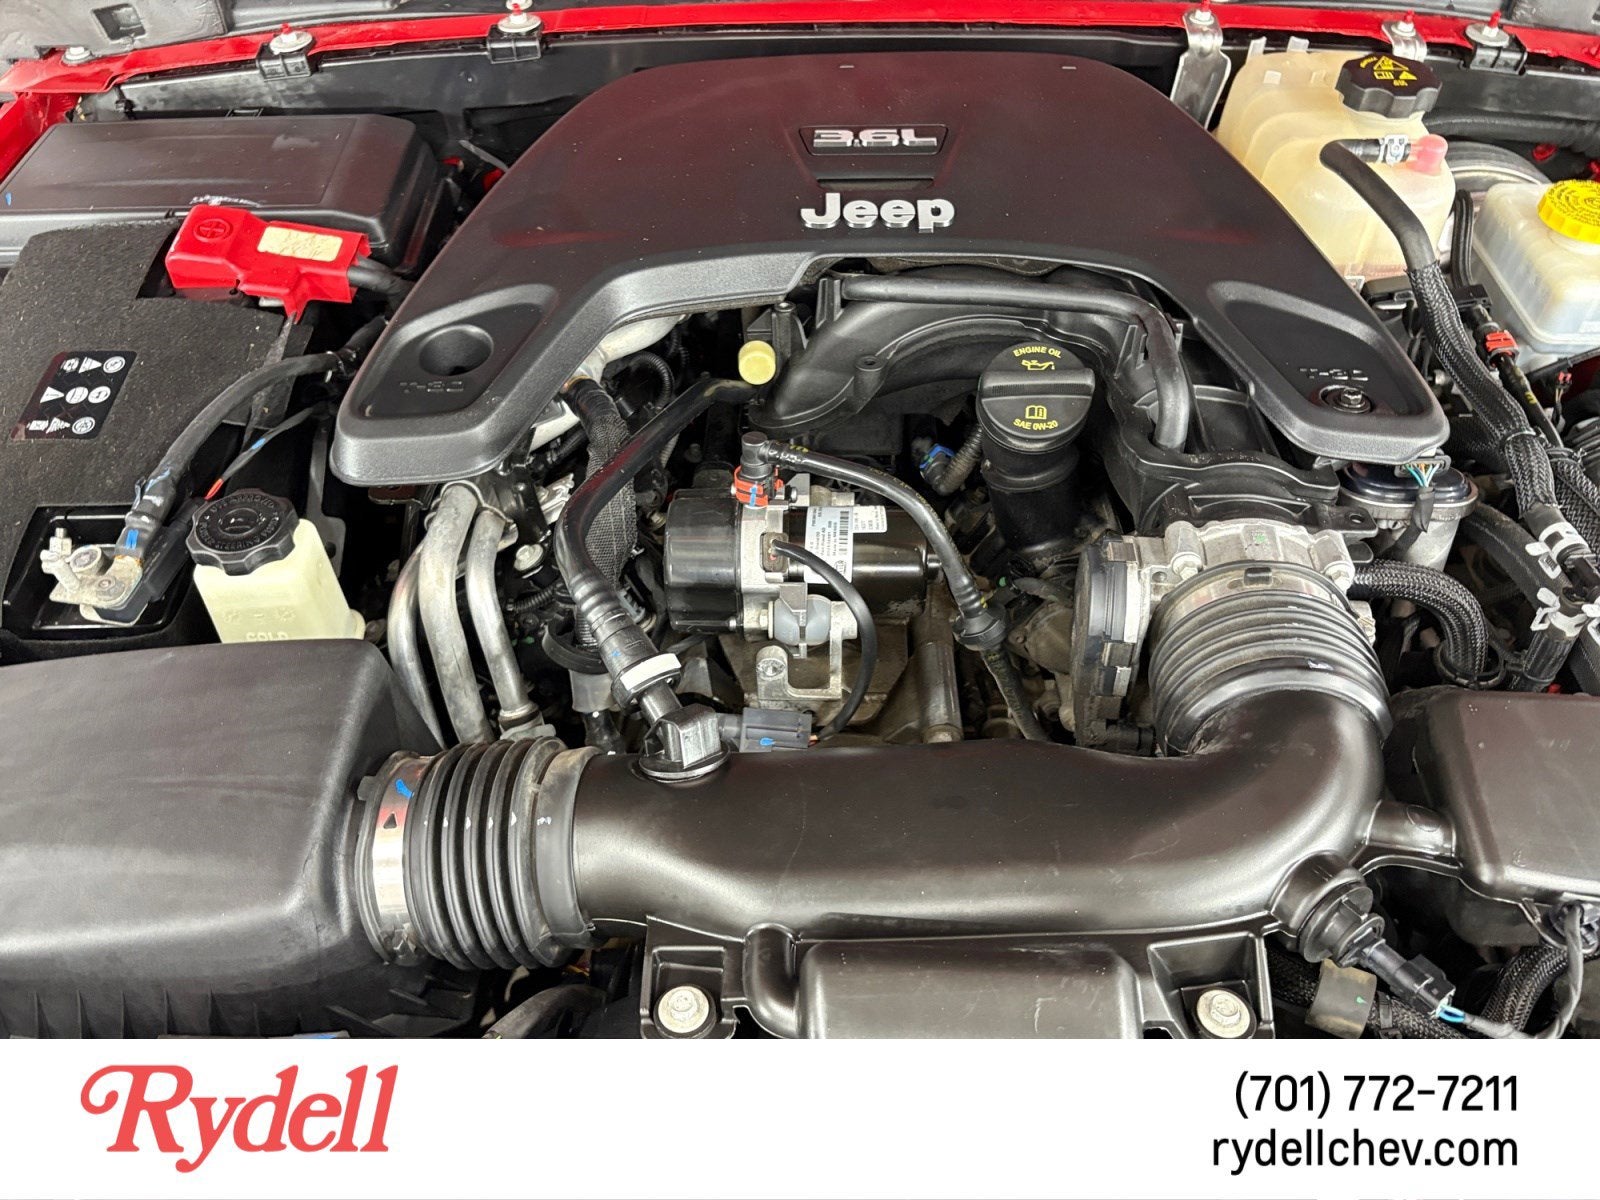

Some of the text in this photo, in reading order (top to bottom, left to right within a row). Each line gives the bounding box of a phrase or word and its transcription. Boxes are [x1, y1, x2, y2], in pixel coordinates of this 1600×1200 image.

[813, 128, 938, 148] 3.6L
[800, 192, 955, 234] Jeep
[1012, 346, 1061, 359] ENGINE OIL
[1013, 418, 1031, 430] SAE
